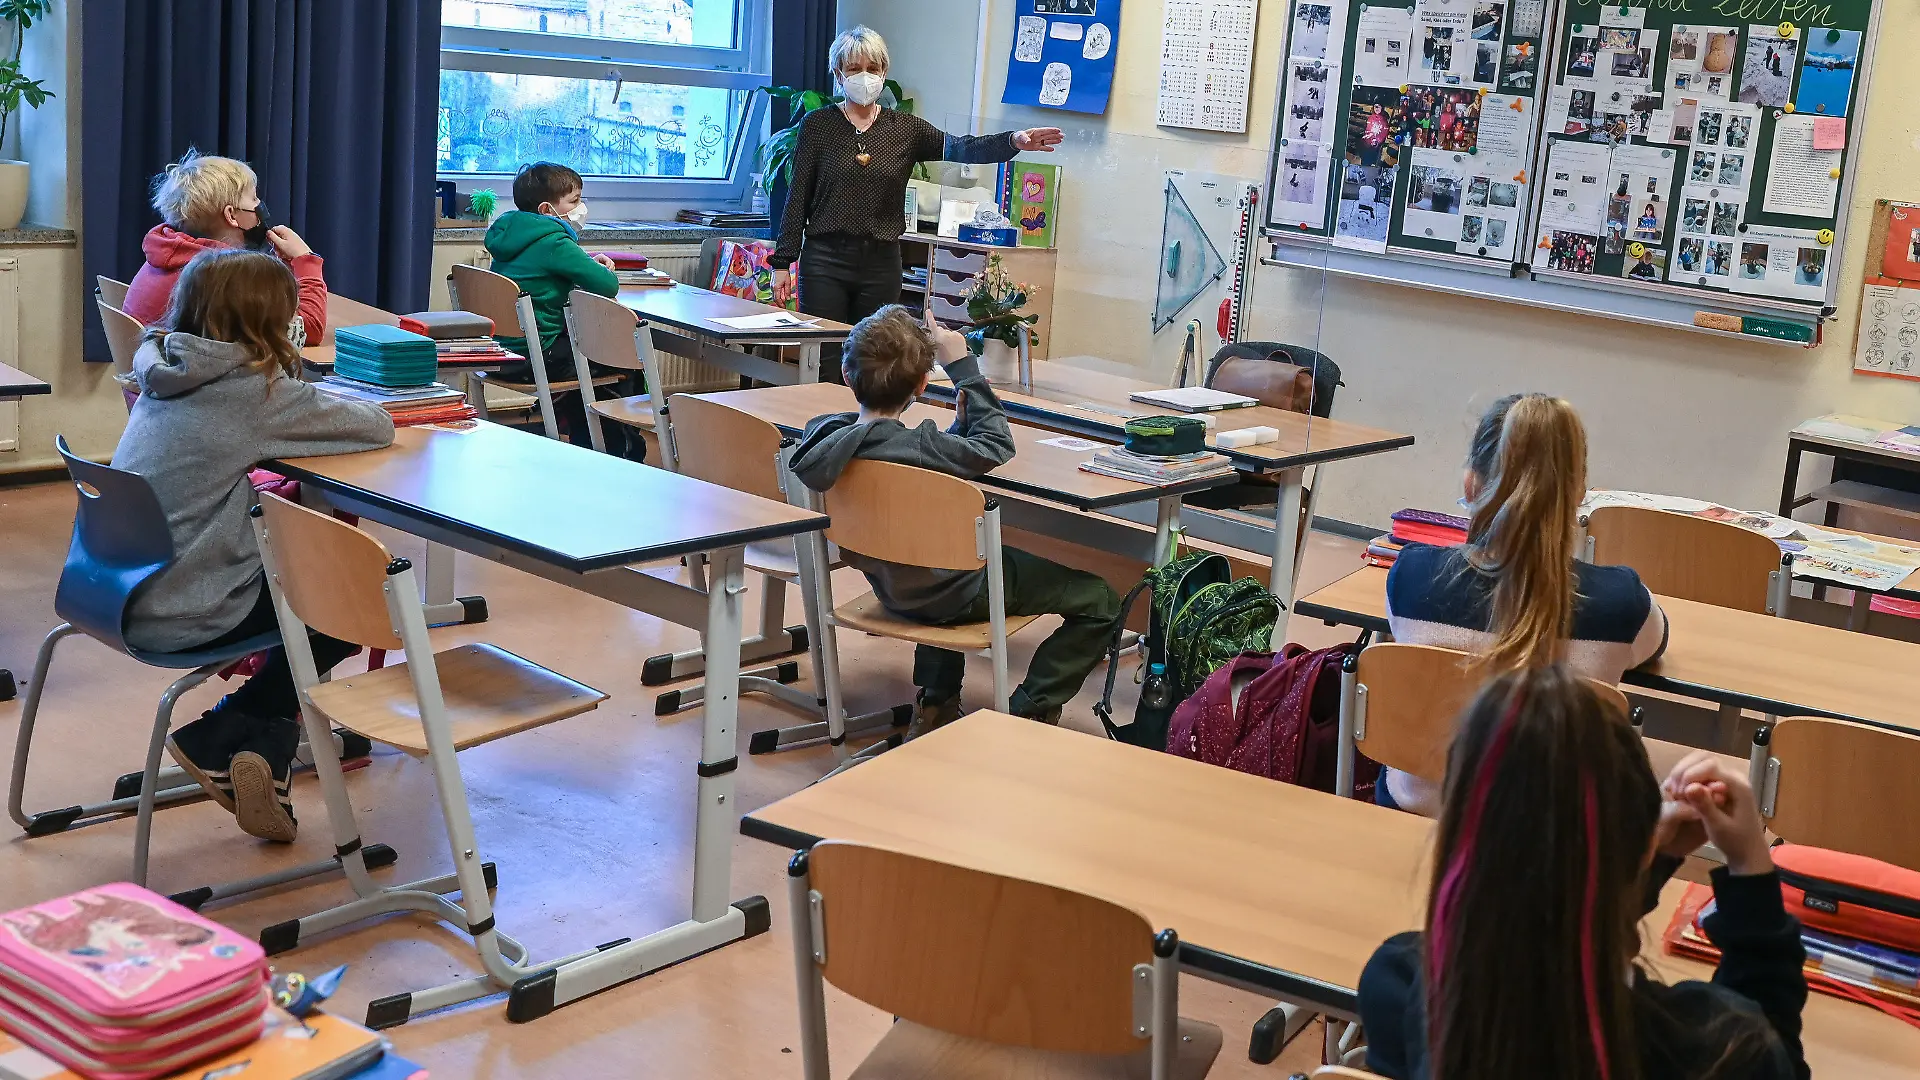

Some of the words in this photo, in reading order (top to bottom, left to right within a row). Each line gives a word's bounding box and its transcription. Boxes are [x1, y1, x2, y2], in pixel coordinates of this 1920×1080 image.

[1212, 10, 1217, 18] 7
[1165, 39, 1170, 47] 3
[1162, 70, 1167, 78] 4
[1202, 105, 1211, 114] 10
